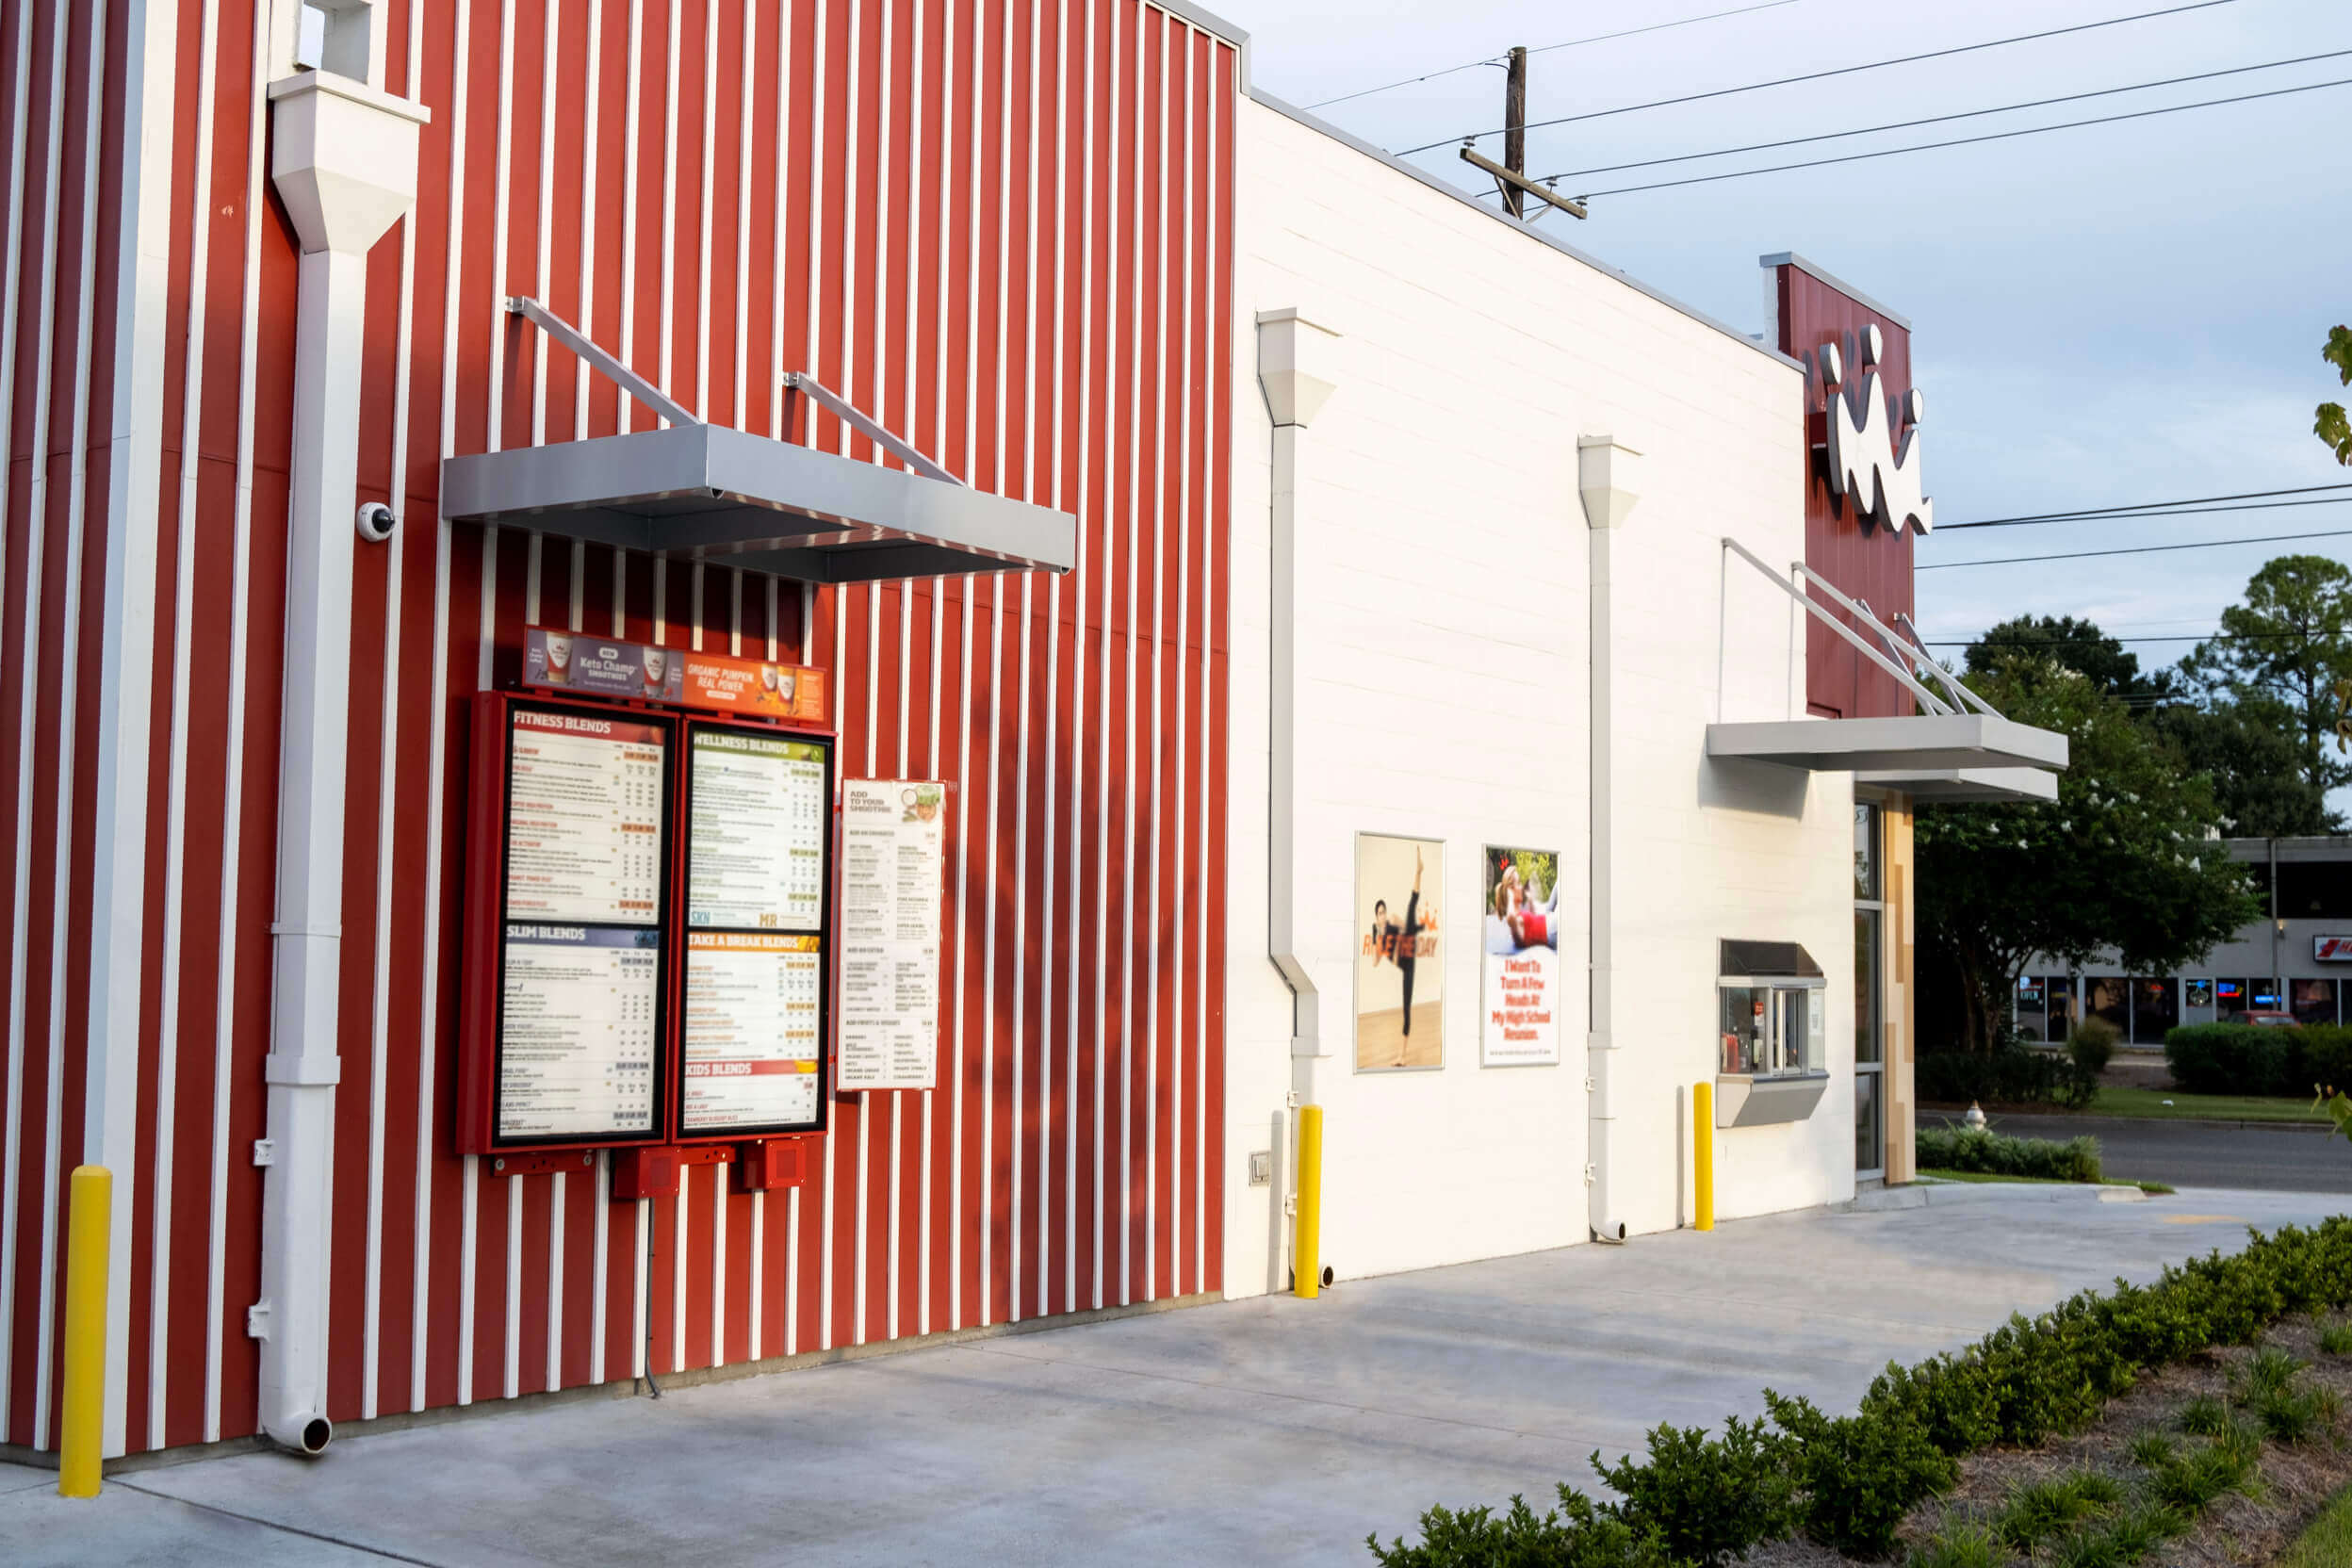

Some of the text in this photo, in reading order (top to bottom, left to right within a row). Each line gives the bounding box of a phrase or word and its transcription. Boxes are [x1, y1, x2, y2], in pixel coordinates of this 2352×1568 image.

[580, 657, 635, 676] Keto Champ
[687, 663, 720, 678] ORGANIC
[721, 668, 754, 682] PUMPKIN
[696, 677, 716, 689] REAL
[514, 710, 612, 734] FITNESS BLENDS
[694, 732, 790, 754] WELLNESS BLENDS
[759, 913, 778, 928] MR
[506, 924, 586, 940] SLIM BLENDS
[689, 933, 798, 950] TAKE A BREAK BLENDS
[1416, 935, 1439, 957] DAY
[1505, 959, 1542, 973] I Want To
[1500, 976, 1545, 990] Turn A Few
[1505, 993, 1541, 1006] Heads At
[1492, 1010, 1551, 1027] My High School
[686, 1062, 753, 1076] KIDS BLENDS
